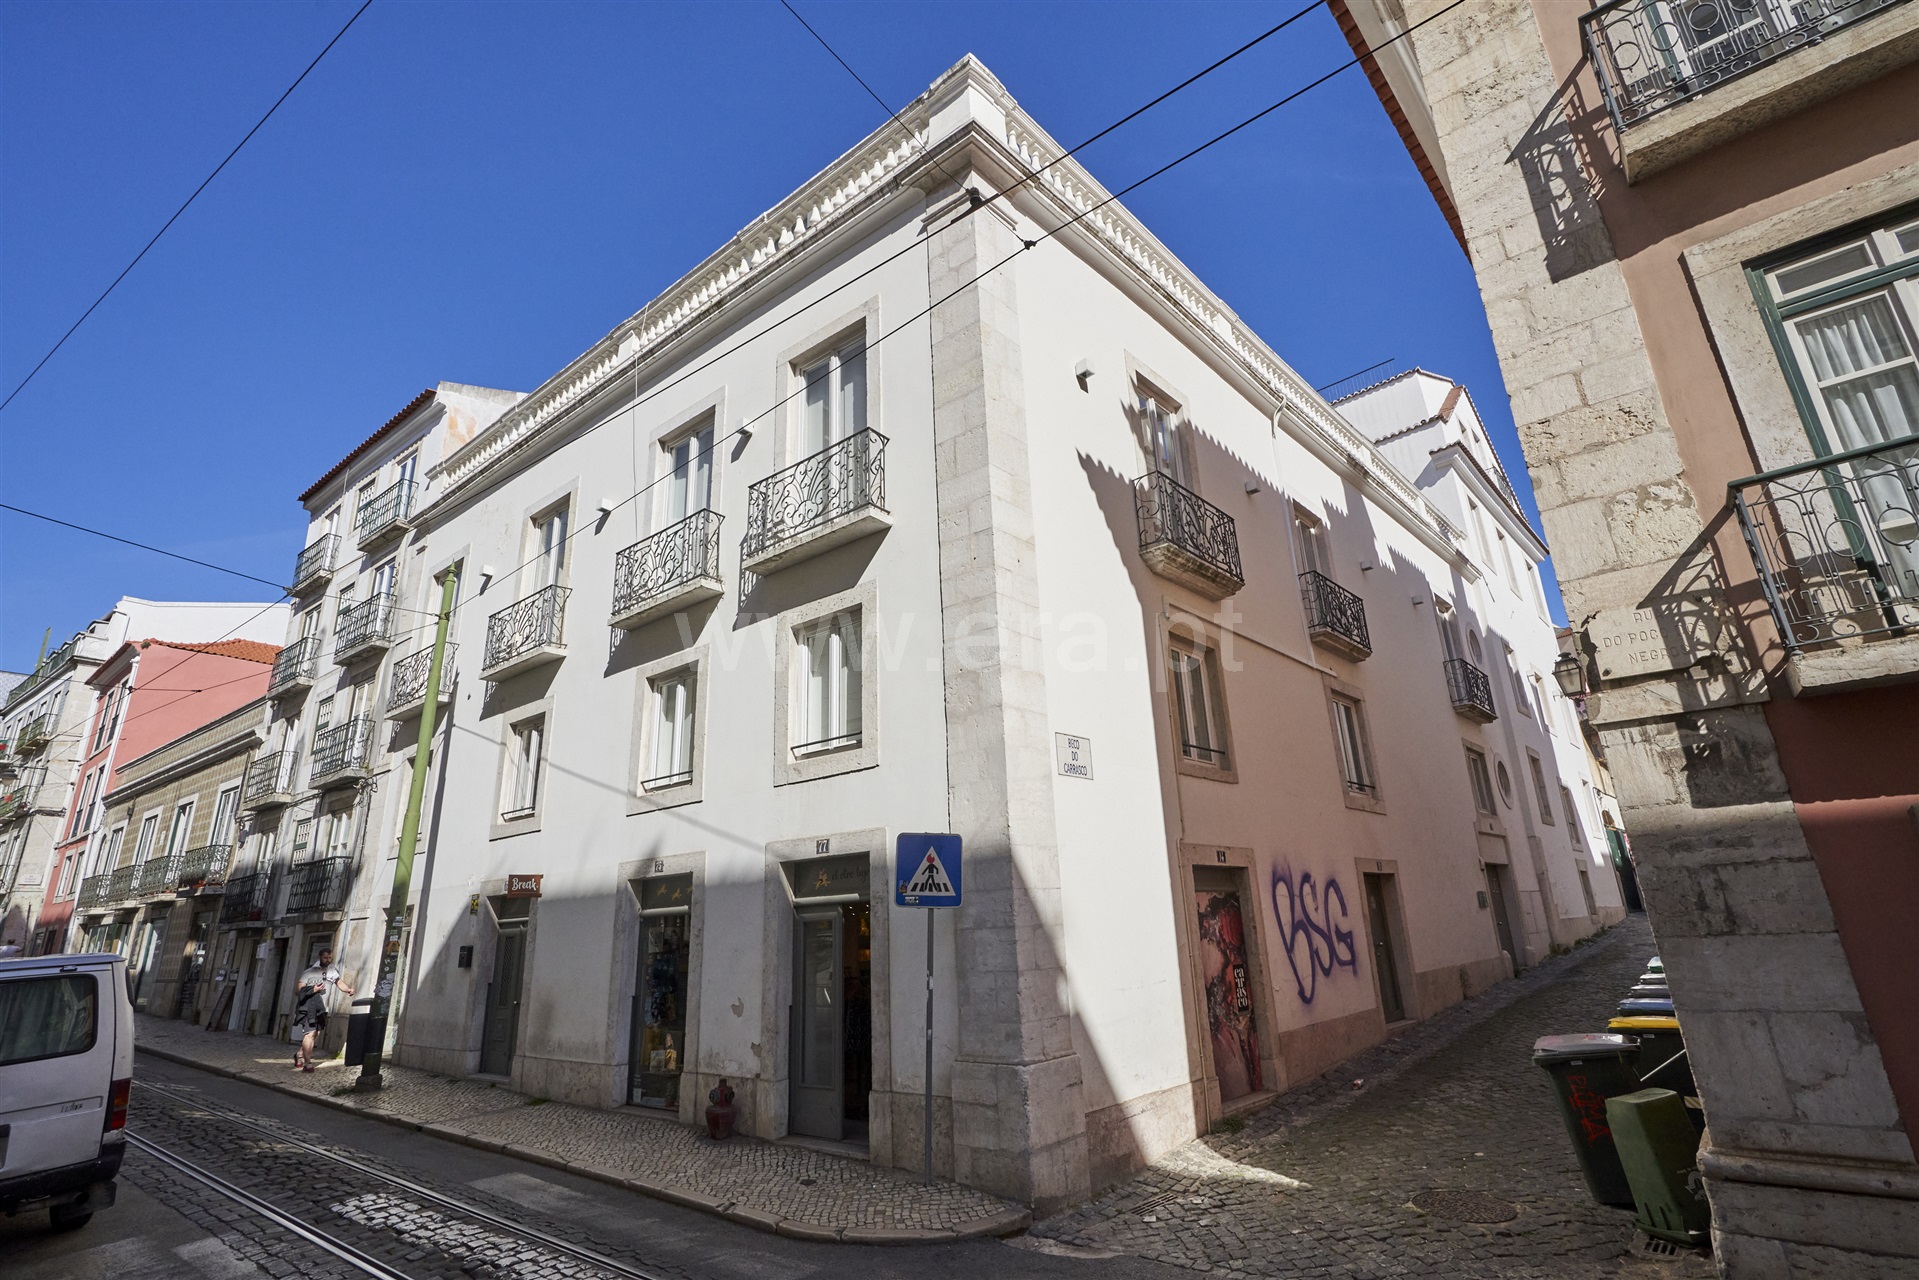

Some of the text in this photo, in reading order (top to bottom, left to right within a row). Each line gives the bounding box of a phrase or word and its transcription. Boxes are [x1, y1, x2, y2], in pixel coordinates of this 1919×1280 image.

[1602, 634, 1623, 648] DO
[1067, 737, 1080, 750] BECO
[1071, 750, 1079, 762] DO
[1063, 762, 1088, 777] CARRASCO
